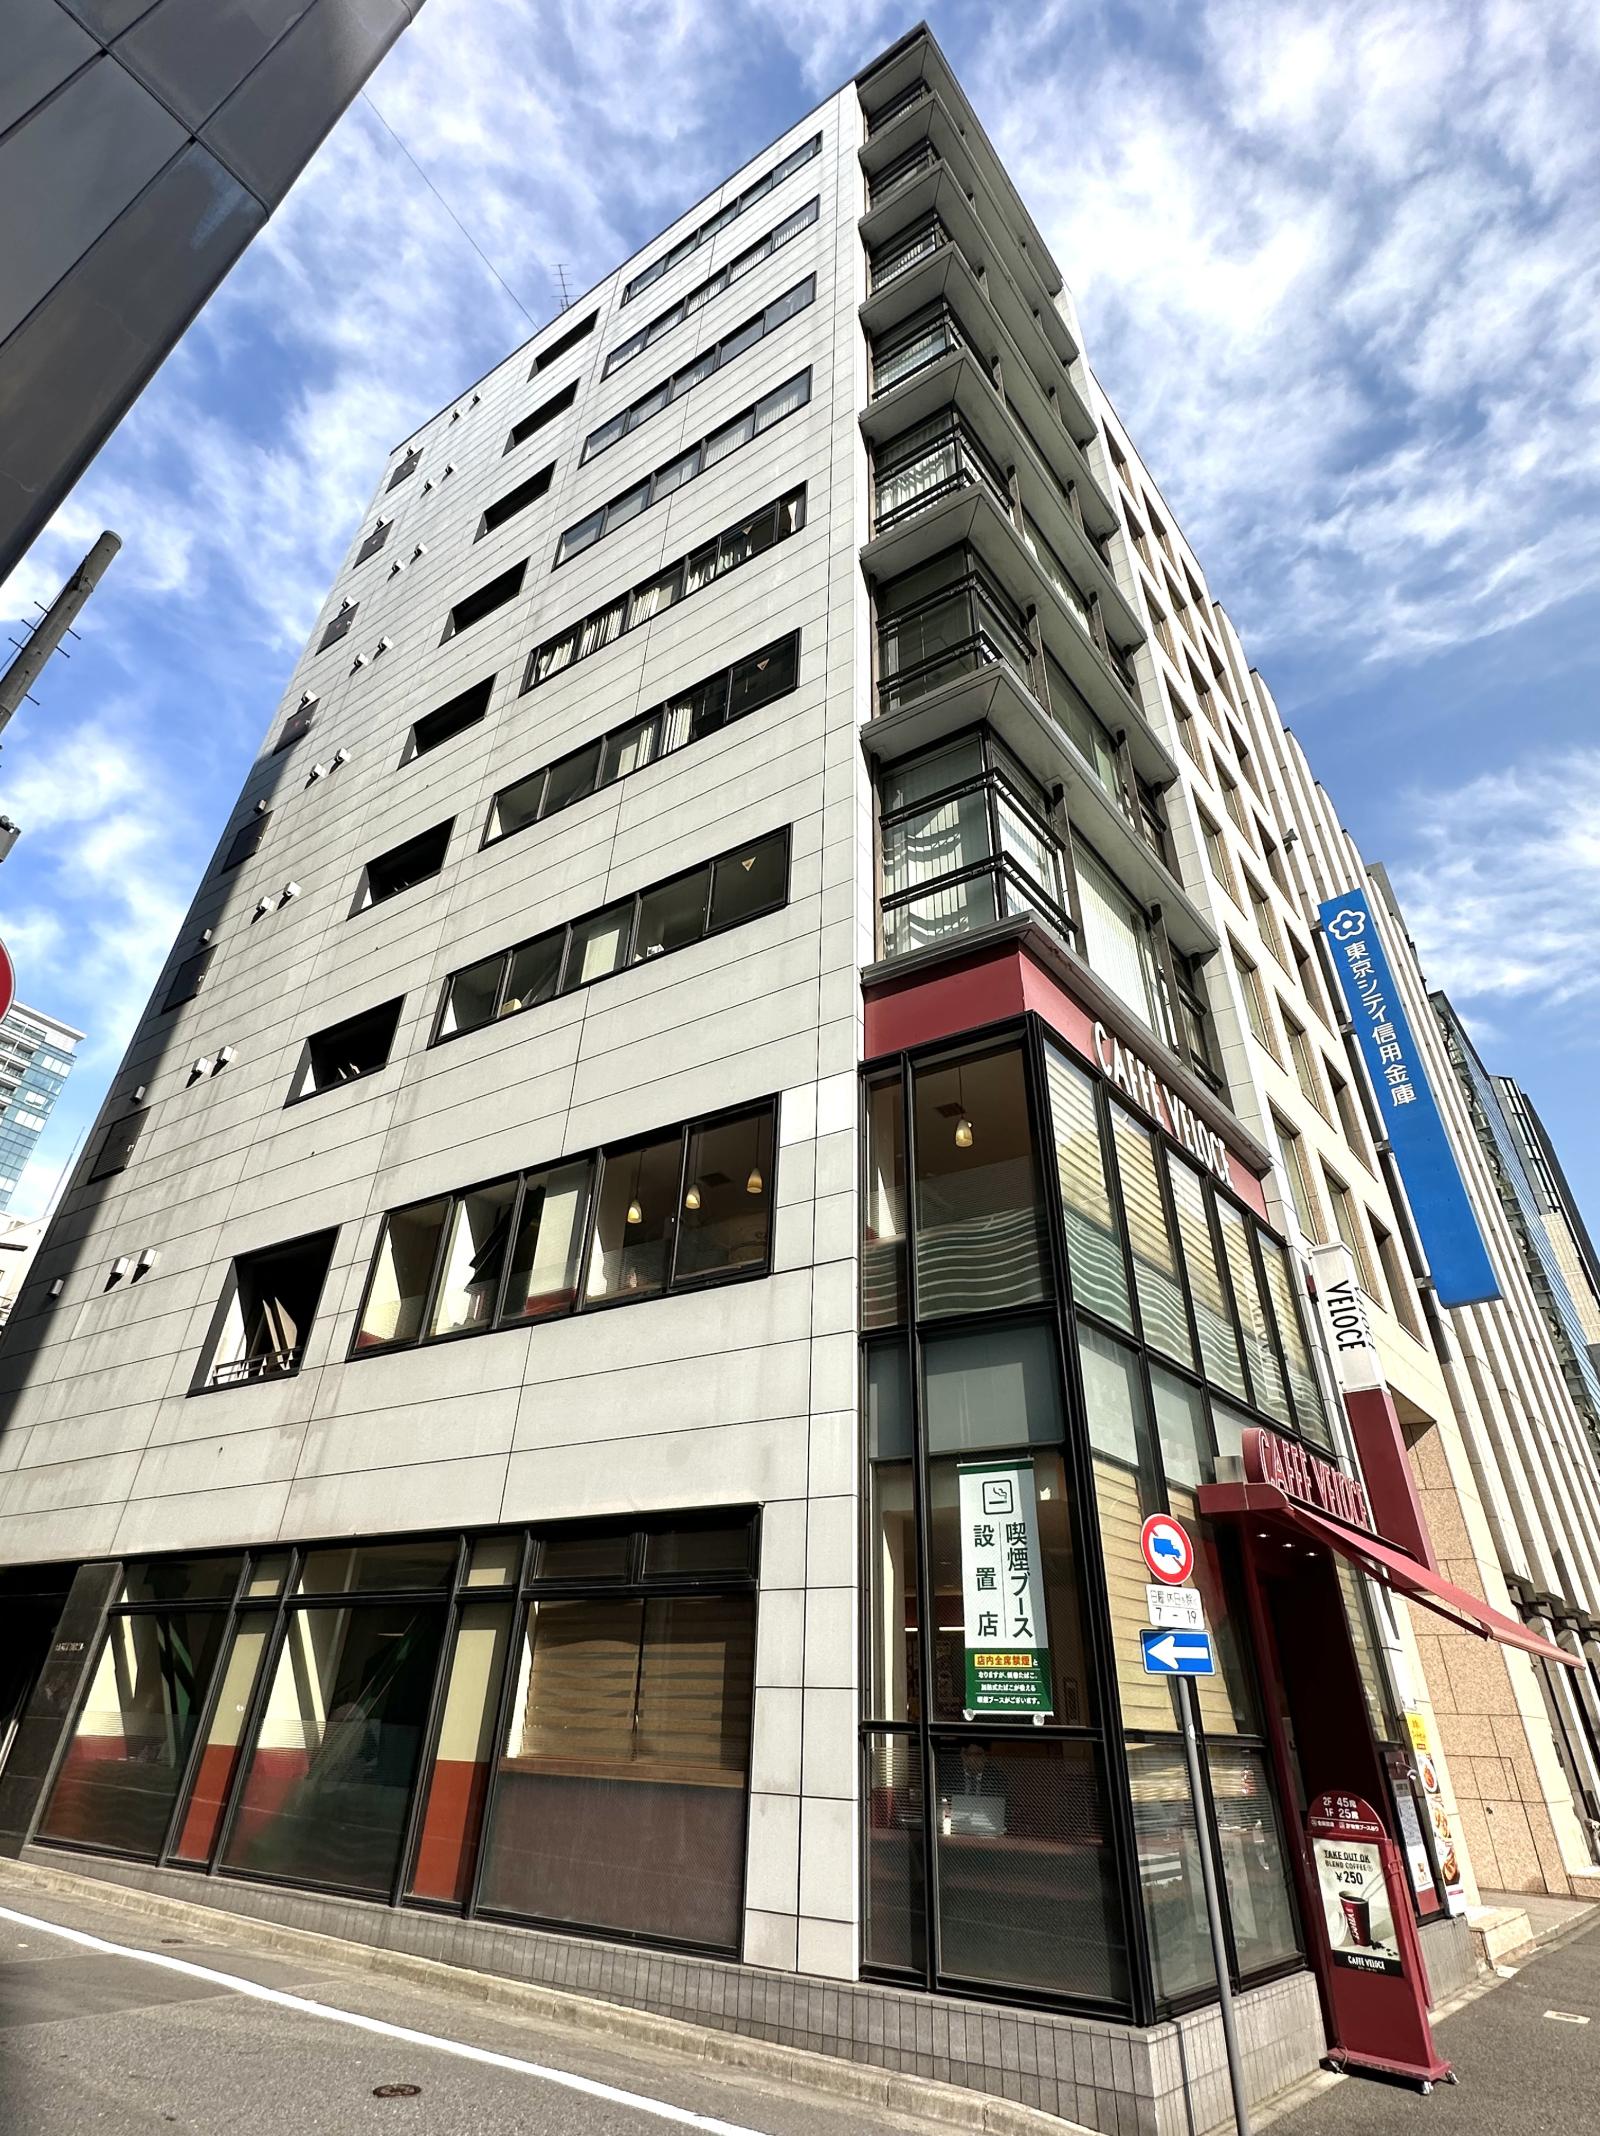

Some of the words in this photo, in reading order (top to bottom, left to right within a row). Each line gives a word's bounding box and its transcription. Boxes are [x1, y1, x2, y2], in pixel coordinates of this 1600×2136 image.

[1344, 940, 1417, 1107] 東京シティ信用金庫
[1162, 1083, 1235, 1191] VELOCE
[1325, 1280, 1366, 1351] VELOCE
[1310, 1454, 1369, 1531] VELOCE
[973, 1524, 998, 1637] 設置店
[1006, 1522, 1033, 1638] 喫煙ブース
[1155, 1607, 1162, 1621] 7
[1186, 1610, 1197, 1624] 19
[1322, 1796, 1332, 1806] 2F
[1324, 1807, 1334, 1817] 1F
[1323, 1849, 1342, 1860] TAKE
[1343, 1852, 1358, 1861] OUT
[1359, 1854, 1371, 1863] OK
[1324, 1860, 1344, 1868] BLEND
